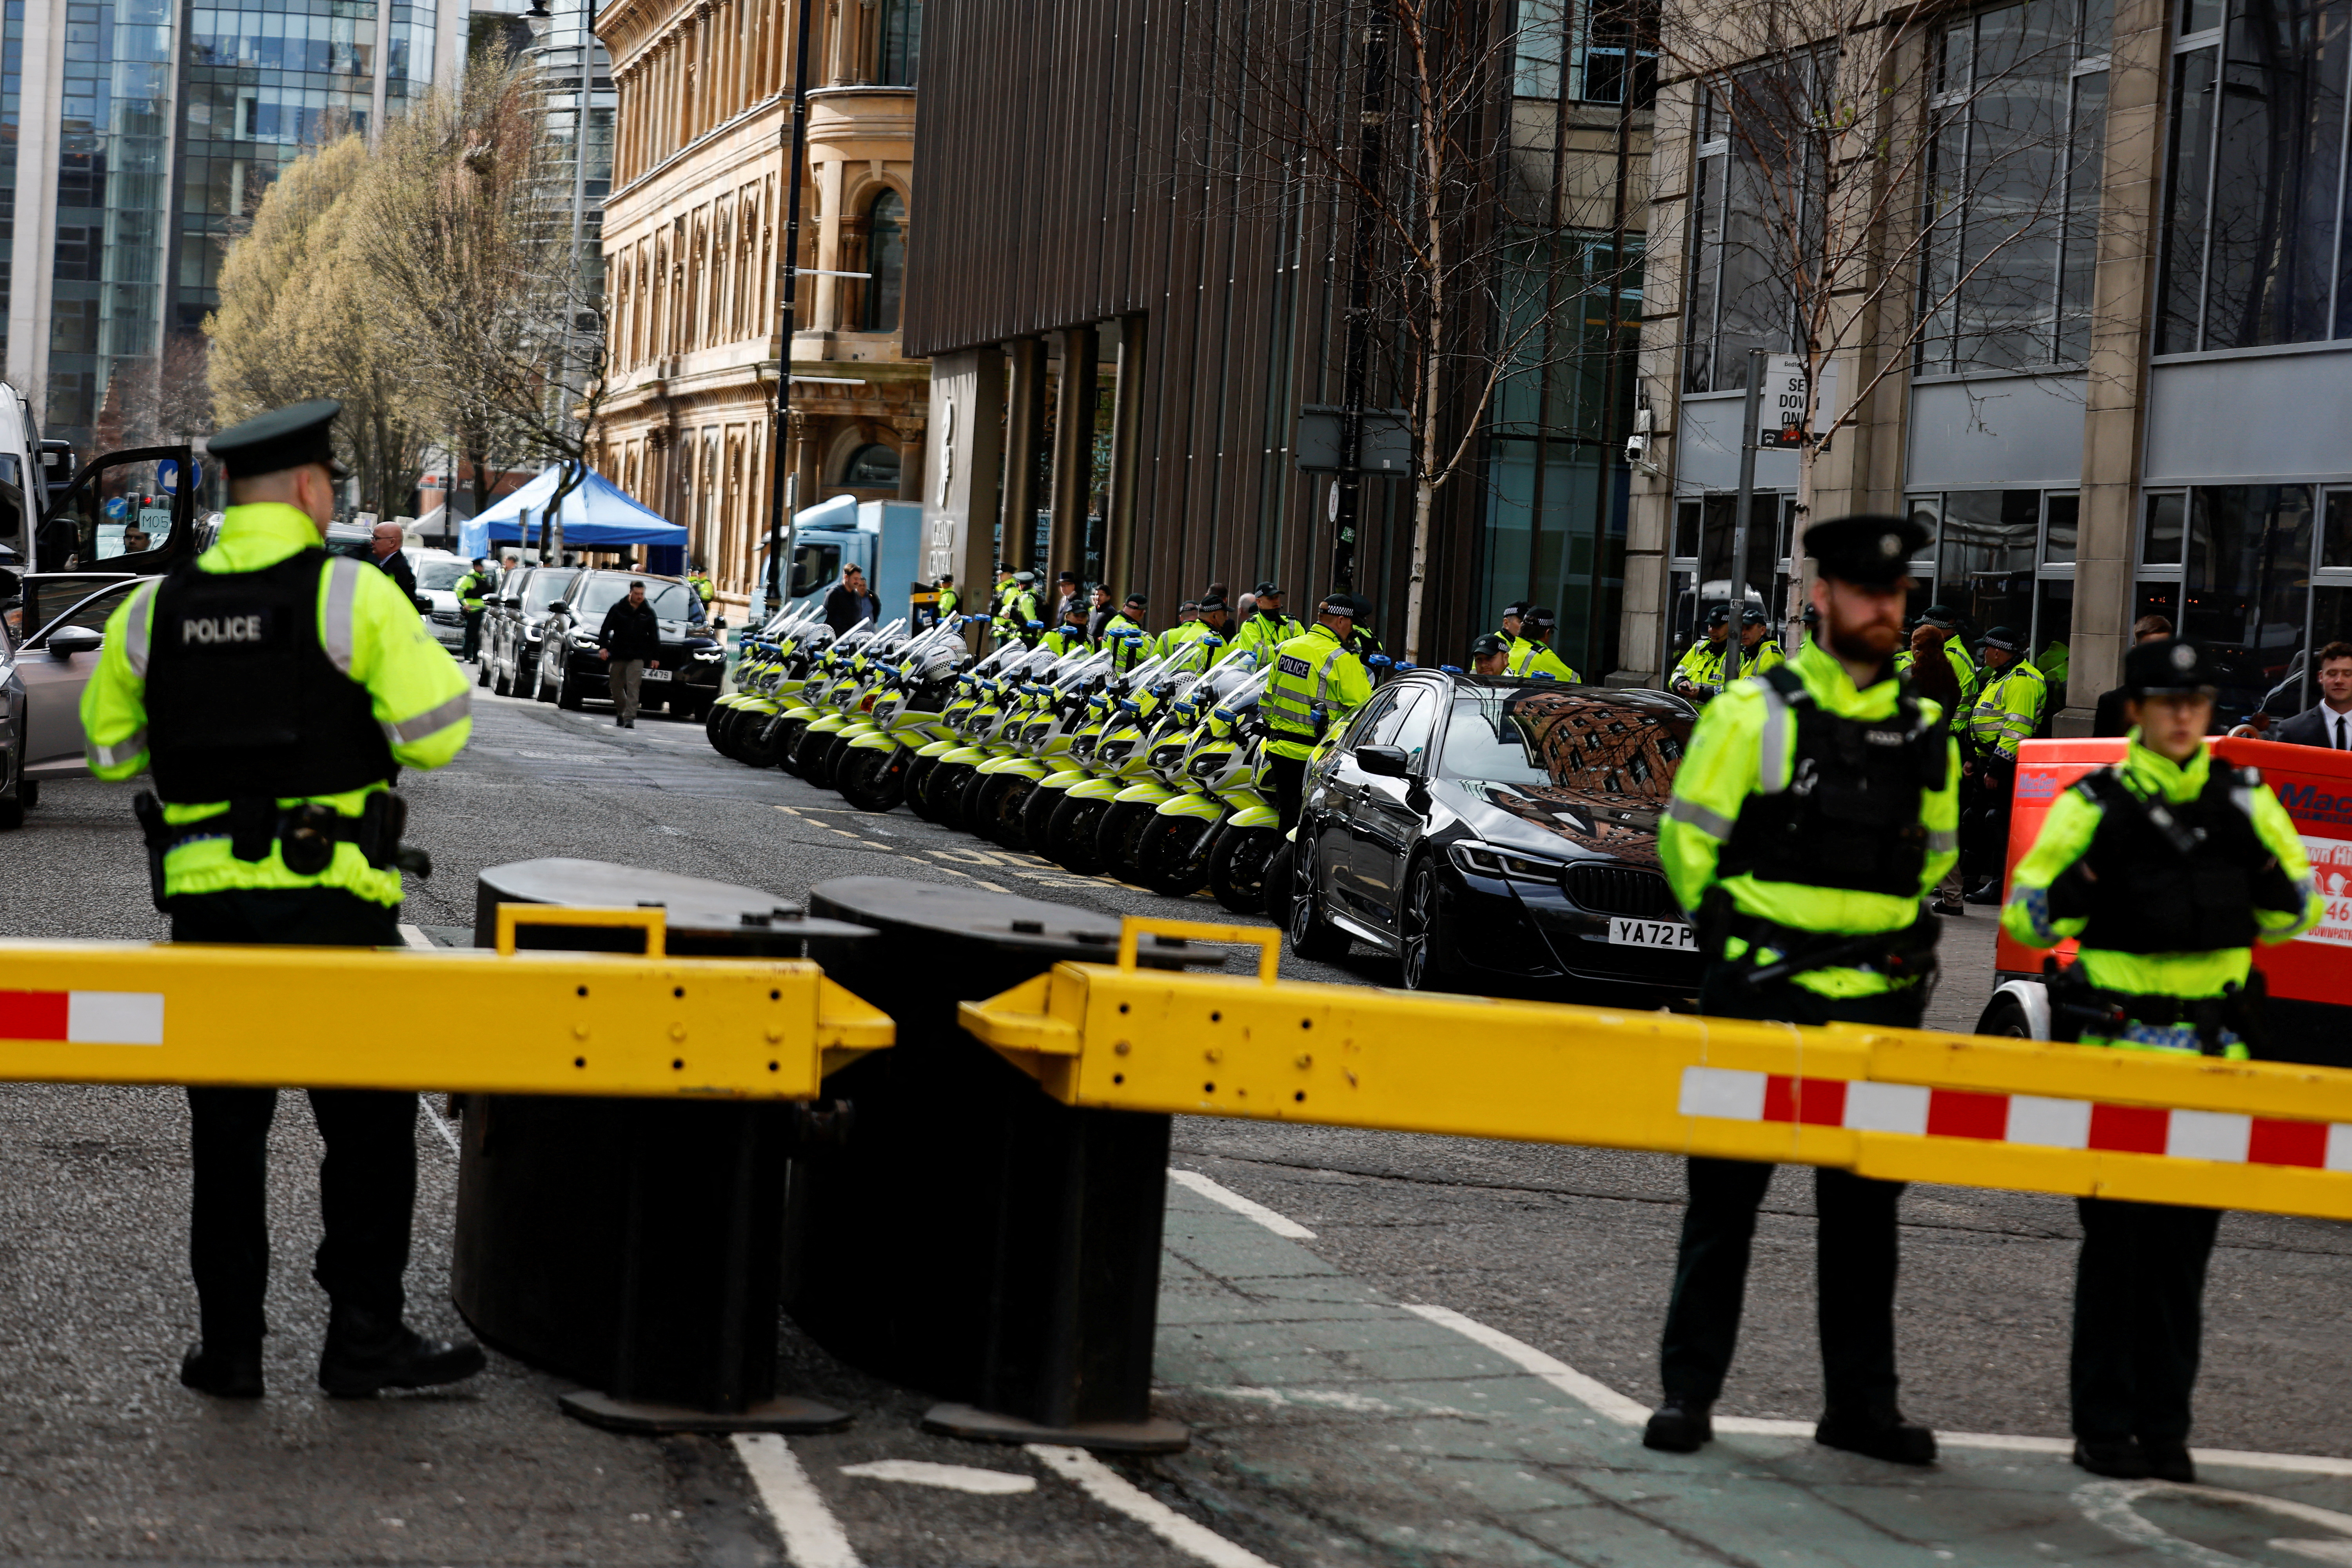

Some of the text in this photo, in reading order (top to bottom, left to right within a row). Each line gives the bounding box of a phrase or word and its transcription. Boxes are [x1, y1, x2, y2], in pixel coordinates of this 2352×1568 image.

[1789, 378, 1805, 392] SE
[1780, 394, 1820, 410] DO
[1782, 411, 1803, 425] ON
[934, 520, 953, 545] GRAND
[929, 550, 952, 576] CENTRAL
[183, 615, 261, 645] POLICE
[1279, 657, 1309, 676] POLICE
[2279, 782, 2352, 813] Mac
[2334, 846, 2352, 865] Hi
[2327, 901, 2352, 921] 46
[1620, 921, 1697, 947] YA72 P
